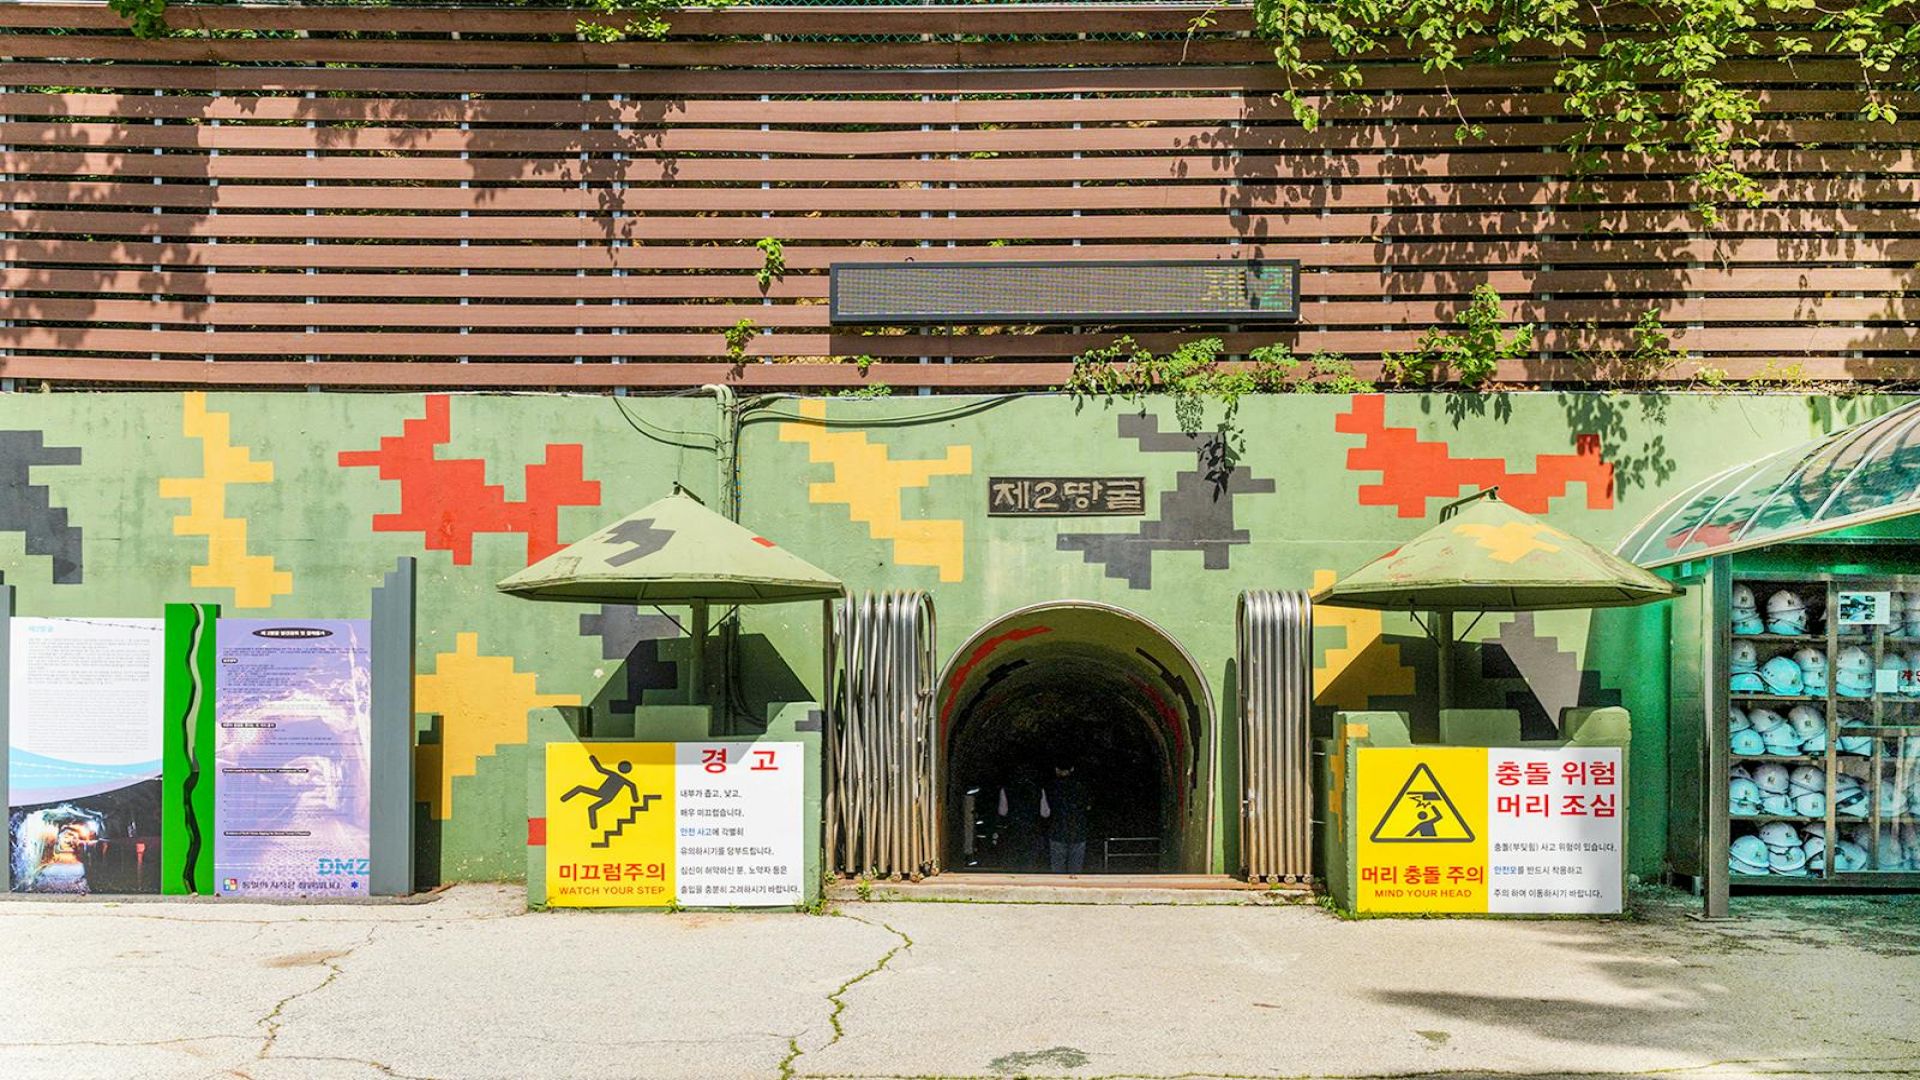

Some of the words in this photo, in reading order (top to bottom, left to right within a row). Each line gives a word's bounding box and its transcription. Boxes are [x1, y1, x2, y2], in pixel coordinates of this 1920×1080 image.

[992, 480, 1142, 510] 제2땅굴
[1495, 761, 1551, 786] 충돌
[1561, 761, 1616, 786] 위험
[1497, 794, 1550, 818] 머리
[1560, 794, 1616, 818] 조심
[680, 808, 695, 818] 매우
[697, 808, 745, 818] 미끄럽습니다.
[680, 827, 696, 837] 안전
[697, 827, 720, 837] 사고에
[721, 827, 744, 837] 각별히
[680, 846, 725, 856] 유의하시기를
[726, 846, 775, 857] 당부드립니다.
[1541, 842, 1556, 852] 사고
[1558, 842, 1582, 853] 위험이
[318, 858, 369, 876] DMZ
[559, 863, 666, 882] 미끄럼주의
[748, 865, 772, 876] 노약자
[1526, 865, 1550, 876] 반드시
[1361, 865, 1398, 885] 머리
[1403, 865, 1441, 885] 충돌
[1446, 865, 1485, 885] 주의
[559, 886, 600, 895] WATCH
[603, 886, 634, 895] YOUR
[636, 886, 666, 895] STEP
[729, 885, 766, 895] 고려하시기
[767, 885, 801, 896] 바랍니다.
[1374, 889, 1404, 898] MIND
[1406, 889, 1438, 898] YOUR
[1440, 889, 1472, 898] HEAD
